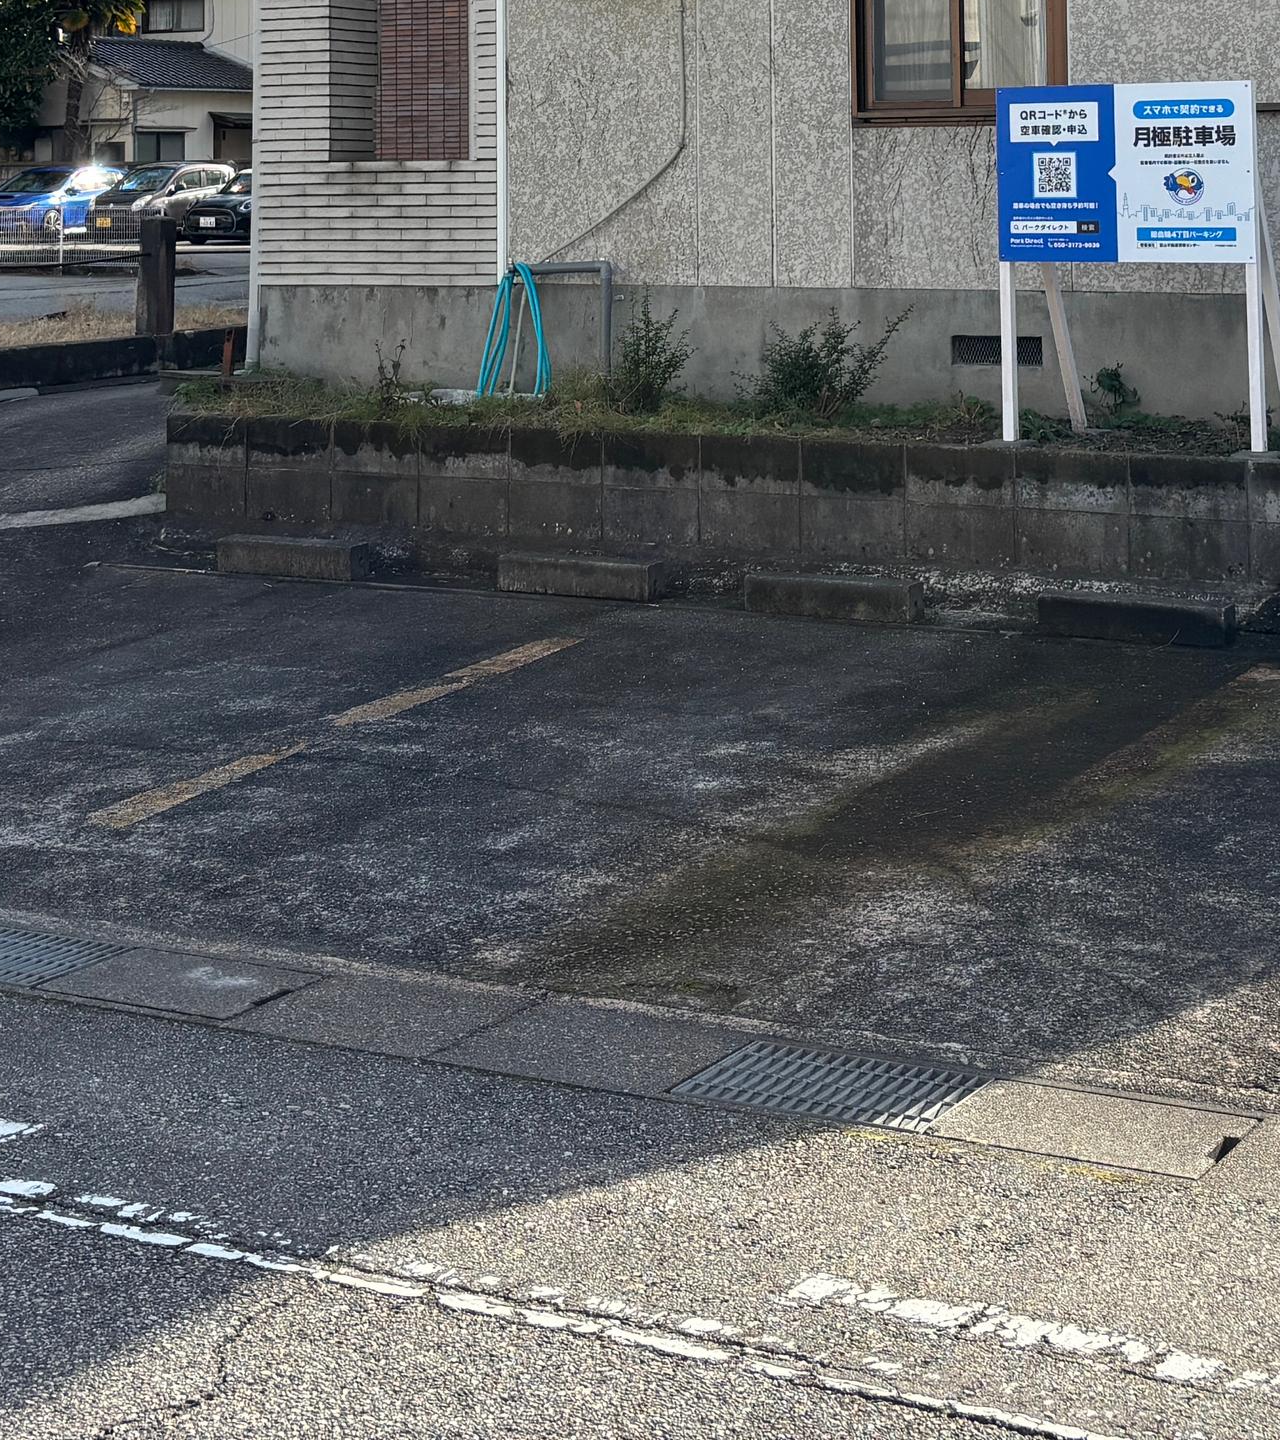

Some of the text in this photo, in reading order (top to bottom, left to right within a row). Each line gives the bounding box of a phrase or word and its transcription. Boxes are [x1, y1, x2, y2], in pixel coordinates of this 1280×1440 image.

[1143, 104, 1224, 115] スマホで契約できる
[1020, 124, 1088, 136] 空車確認・申込
[1133, 125, 1236, 147] 月極駐車場
